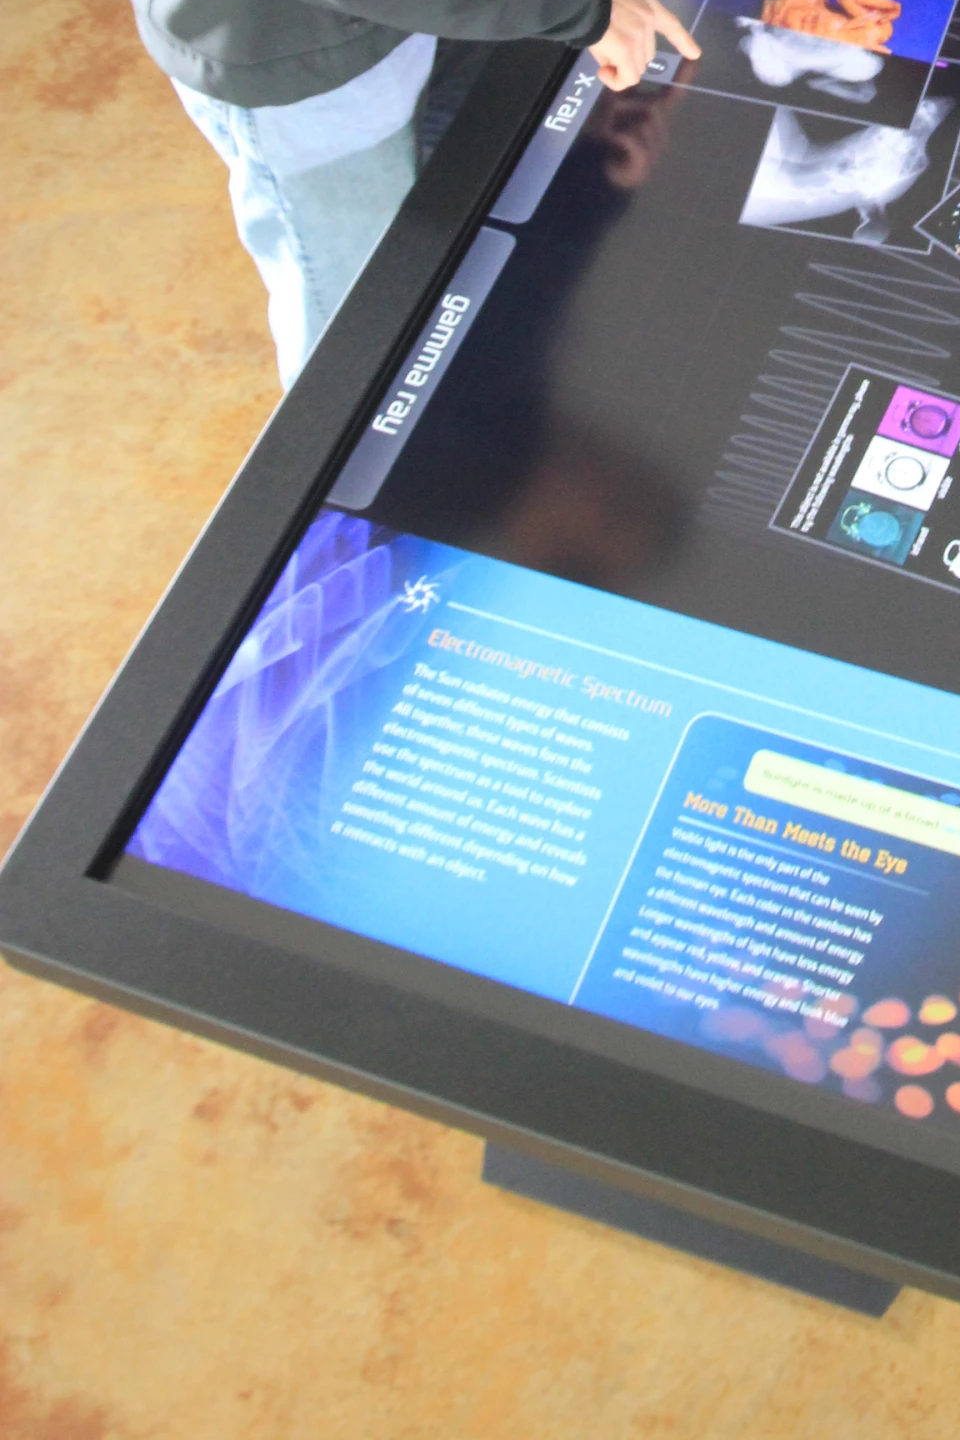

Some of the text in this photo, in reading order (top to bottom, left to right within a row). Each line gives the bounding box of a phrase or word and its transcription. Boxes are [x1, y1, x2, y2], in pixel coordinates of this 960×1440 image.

[544, 72, 596, 131] x-ray
[372, 293, 471, 435] gamma ray
[402, 683, 420, 697] of
[416, 689, 453, 707] seven
[452, 699, 506, 724] different
[506, 716, 539, 735] types
[539, 727, 556, 739] of
[414, 663, 629, 740] The Sun radiates energy that consists
[429, 630, 672, 717] Electromagnetic Spectrum
[383, 723, 480, 761] electromagnetic
[543, 771, 601, 800] Scientists
[392, 701, 413, 716] All
[465, 725, 501, 744] these
[501, 738, 538, 757] waves
[538, 747, 569, 766] form
[570, 758, 592, 774] the
[362, 760, 385, 776] the
[385, 770, 423, 788] world
[420, 781, 468, 803] around
[486, 799, 517, 819] Each
[518, 812, 550, 830] wave
[551, 820, 574, 838] has
[574, 831, 585, 841] a
[372, 742, 591, 819] use the spectrum as a tool to explore
[330, 821, 344, 834] it
[342, 826, 397, 852] interacts
[398, 845, 427, 861] with
[426, 854, 445, 867] an
[342, 802, 577, 886] something different depending on how
[352, 780, 586, 866] different amount of energy and reveals
[672, 827, 830, 886] Visible light is the only part of the
[683, 791, 907, 874] More Than Meets the Eye
[646, 888, 655, 897] a
[654, 888, 699, 910] different
[697, 903, 754, 928] wavelength
[754, 922, 776, 935] and
[775, 929, 816, 948] amount
[815, 939, 829, 951] of
[655, 866, 673, 880] the
[673, 871, 709, 891] human
[729, 889, 755, 906] Each
[754, 899, 782, 914] color
[781, 907, 793, 919] in
[793, 910, 812, 924] the
[812, 917, 853, 937] rainbow
[852, 928, 872, 944] has
[663, 848, 883, 926] electromagnetic spectrum that can be seen by
[630, 927, 652, 941] and
[650, 934, 686, 952] appear
[739, 963, 763, 977] and
[638, 905, 854, 985] Longer wavelengths of light have less energy
[622, 948, 848, 1028] wavelengths have higher energy and look blue
